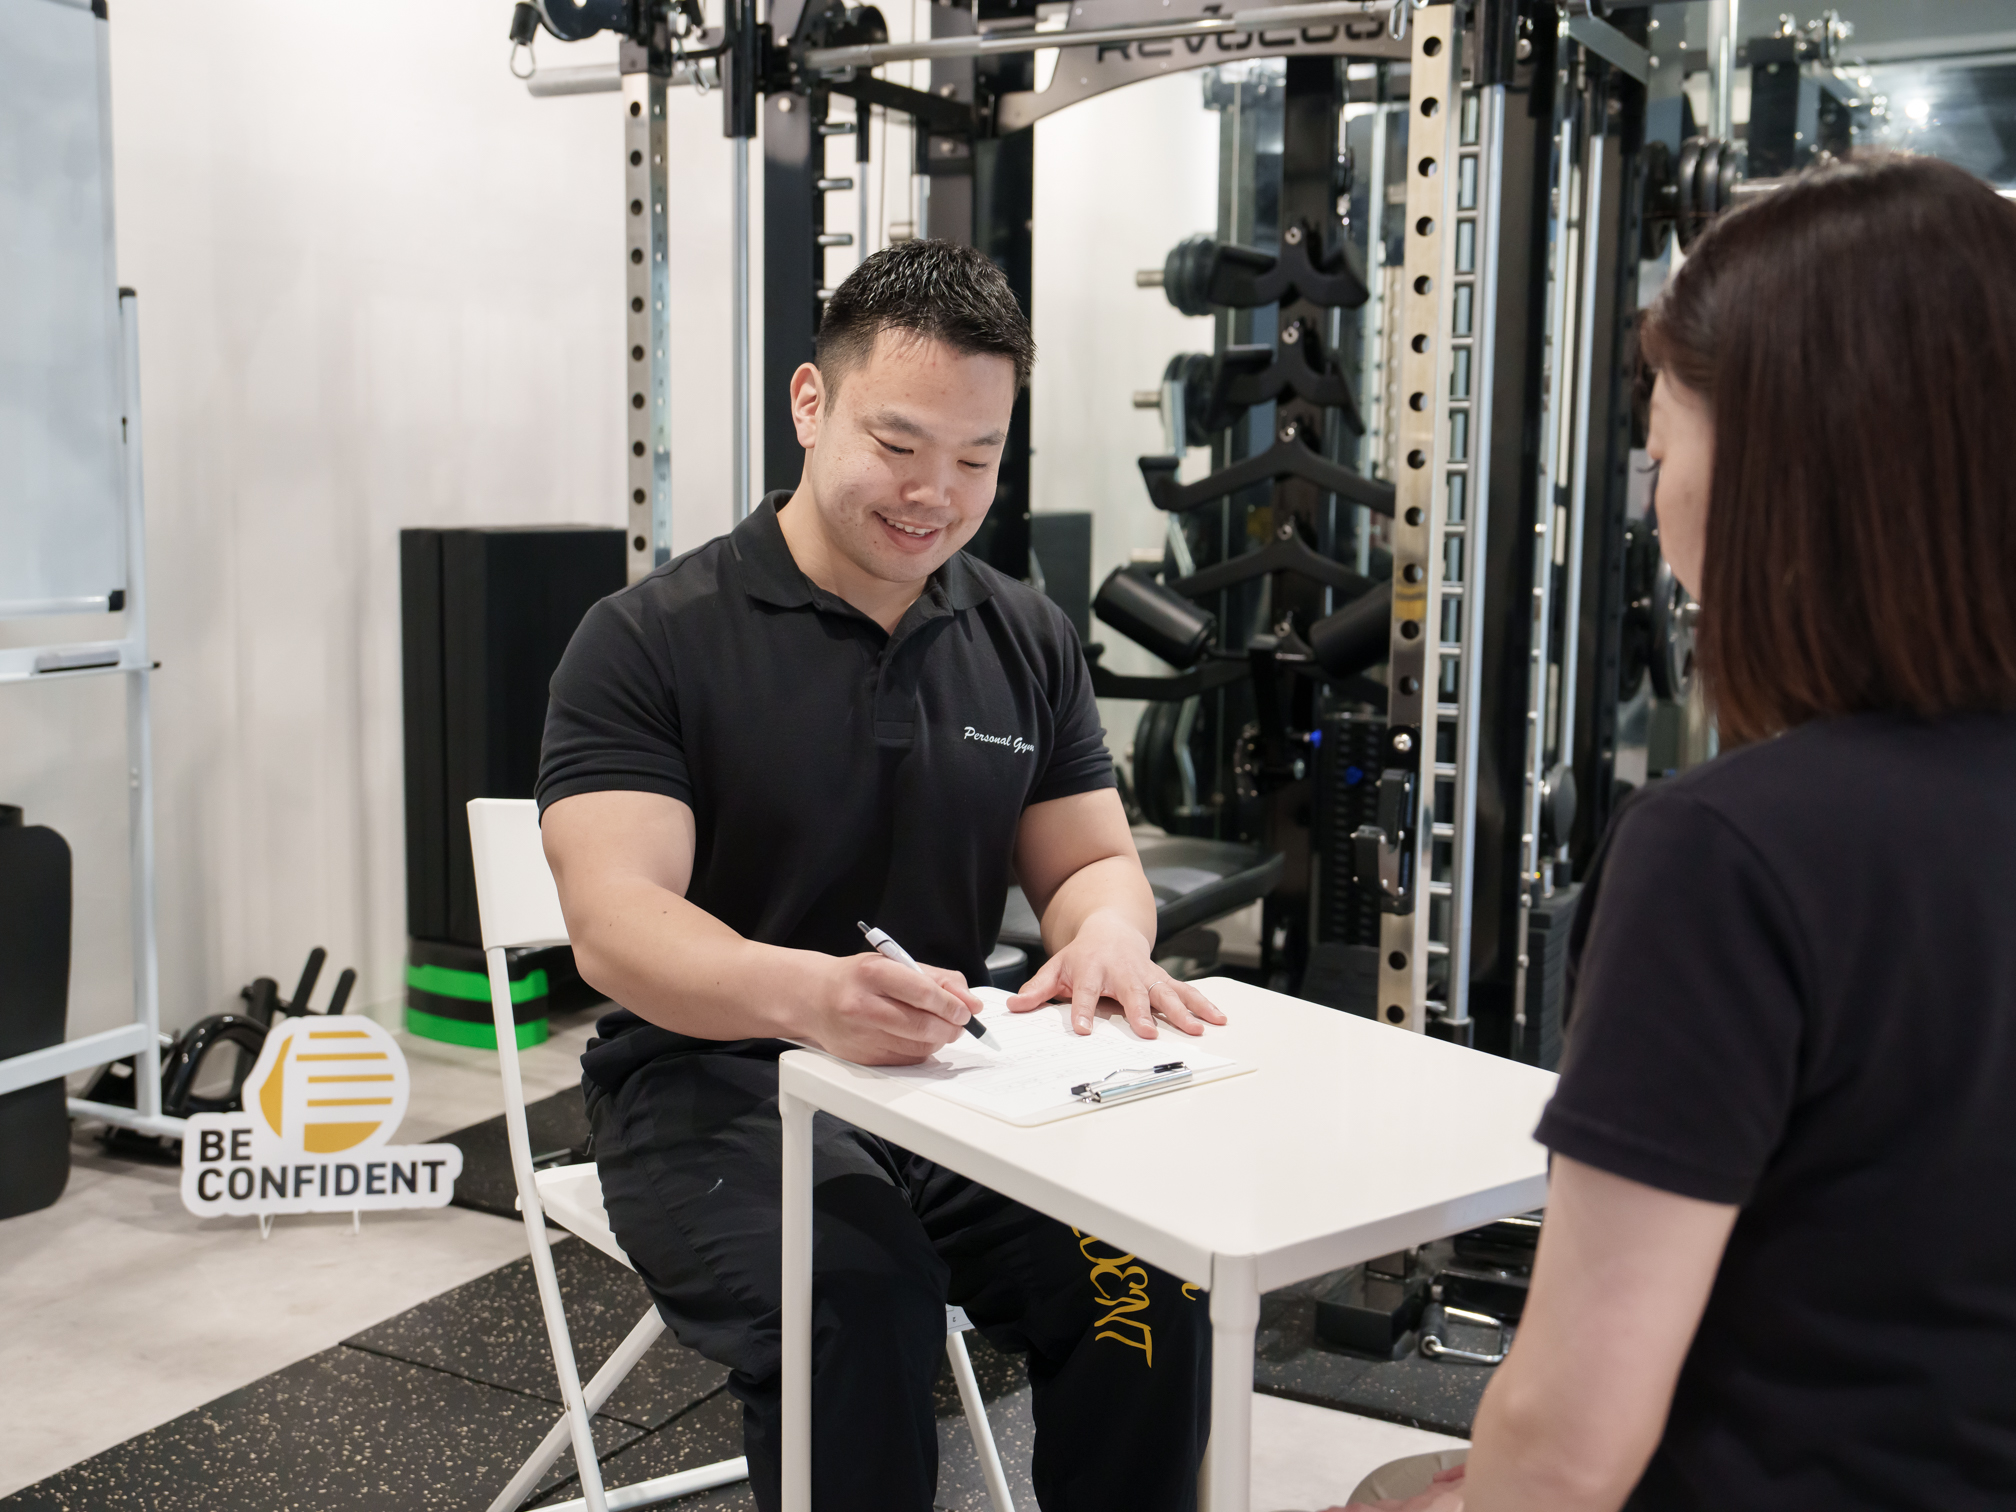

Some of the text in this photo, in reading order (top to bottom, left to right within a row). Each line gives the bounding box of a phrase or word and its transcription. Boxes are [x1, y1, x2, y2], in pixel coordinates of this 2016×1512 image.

[963, 726, 1035, 754] Personal Gym
[199, 1128, 253, 1162] BE
[197, 1159, 447, 1202] CONFIDENT
[1071, 1226, 1153, 1369] DENT
